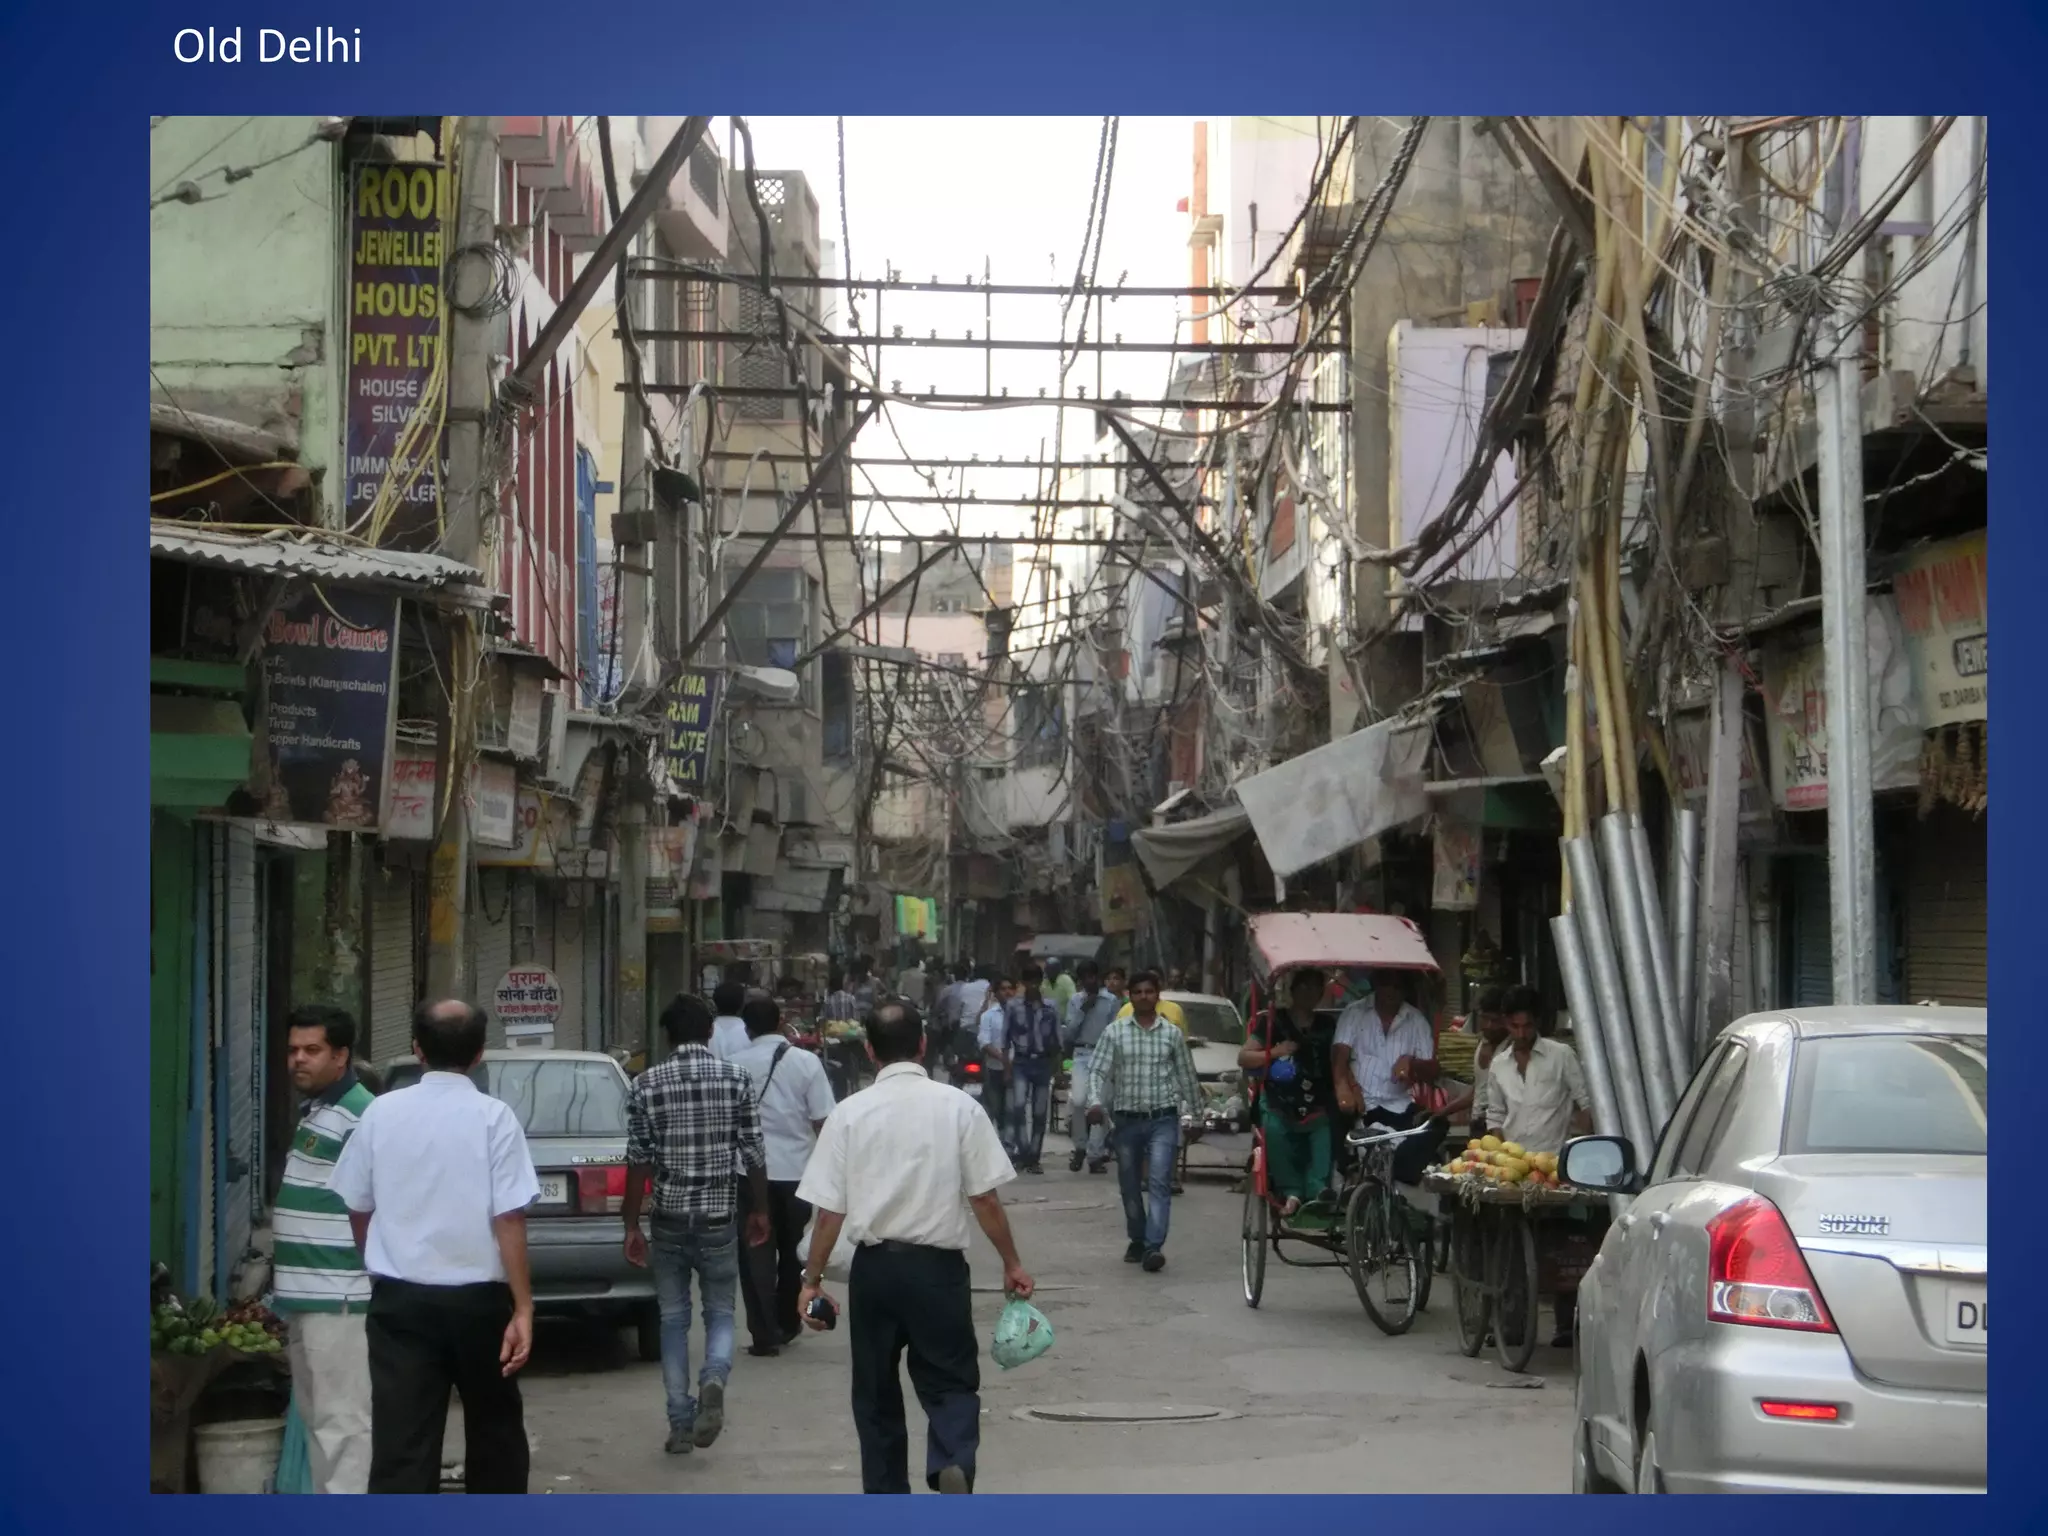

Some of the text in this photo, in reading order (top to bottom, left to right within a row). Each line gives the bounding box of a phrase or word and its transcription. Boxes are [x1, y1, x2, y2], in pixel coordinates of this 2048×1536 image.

[353, 333, 400, 367] PVT.
[360, 379, 418, 397] HOUSE
[269, 609, 320, 646] Bowl
[274, 672, 306, 688] Bowls
[301, 734, 361, 751] Handicrafts
[666, 728, 706, 753] LATE
[667, 756, 697, 780] ALA
[508, 972, 547, 988] पुराना
[1819, 1213, 1889, 1224] MARUTI
[1819, 1222, 1889, 1235] SUZUKI
